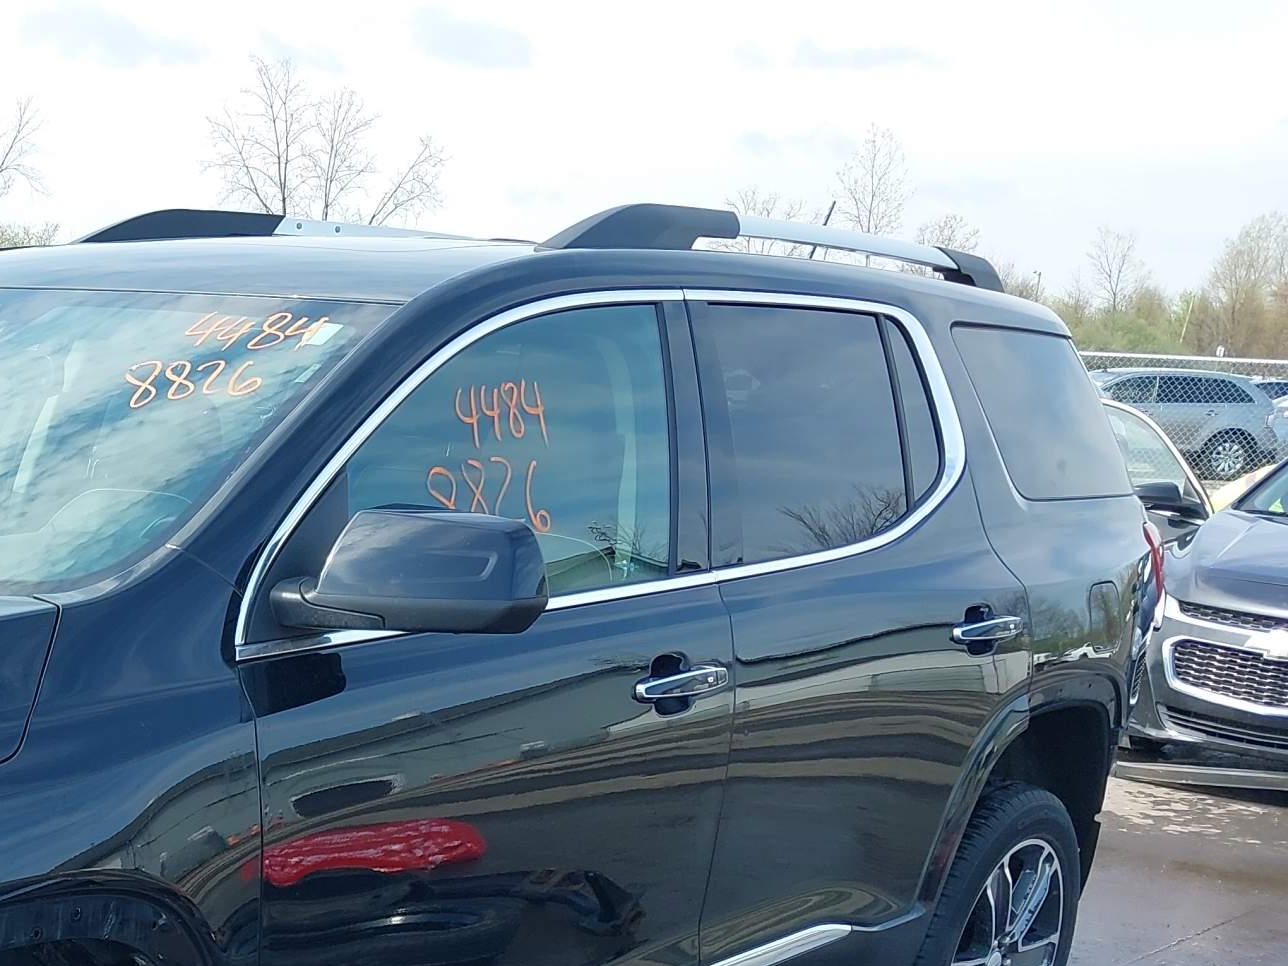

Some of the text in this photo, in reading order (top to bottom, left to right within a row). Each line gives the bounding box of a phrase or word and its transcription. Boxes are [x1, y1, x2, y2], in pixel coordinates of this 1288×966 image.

[185, 311, 330, 351] 4484
[125, 360, 263, 409] 8826
[455, 378, 550, 449] 4484
